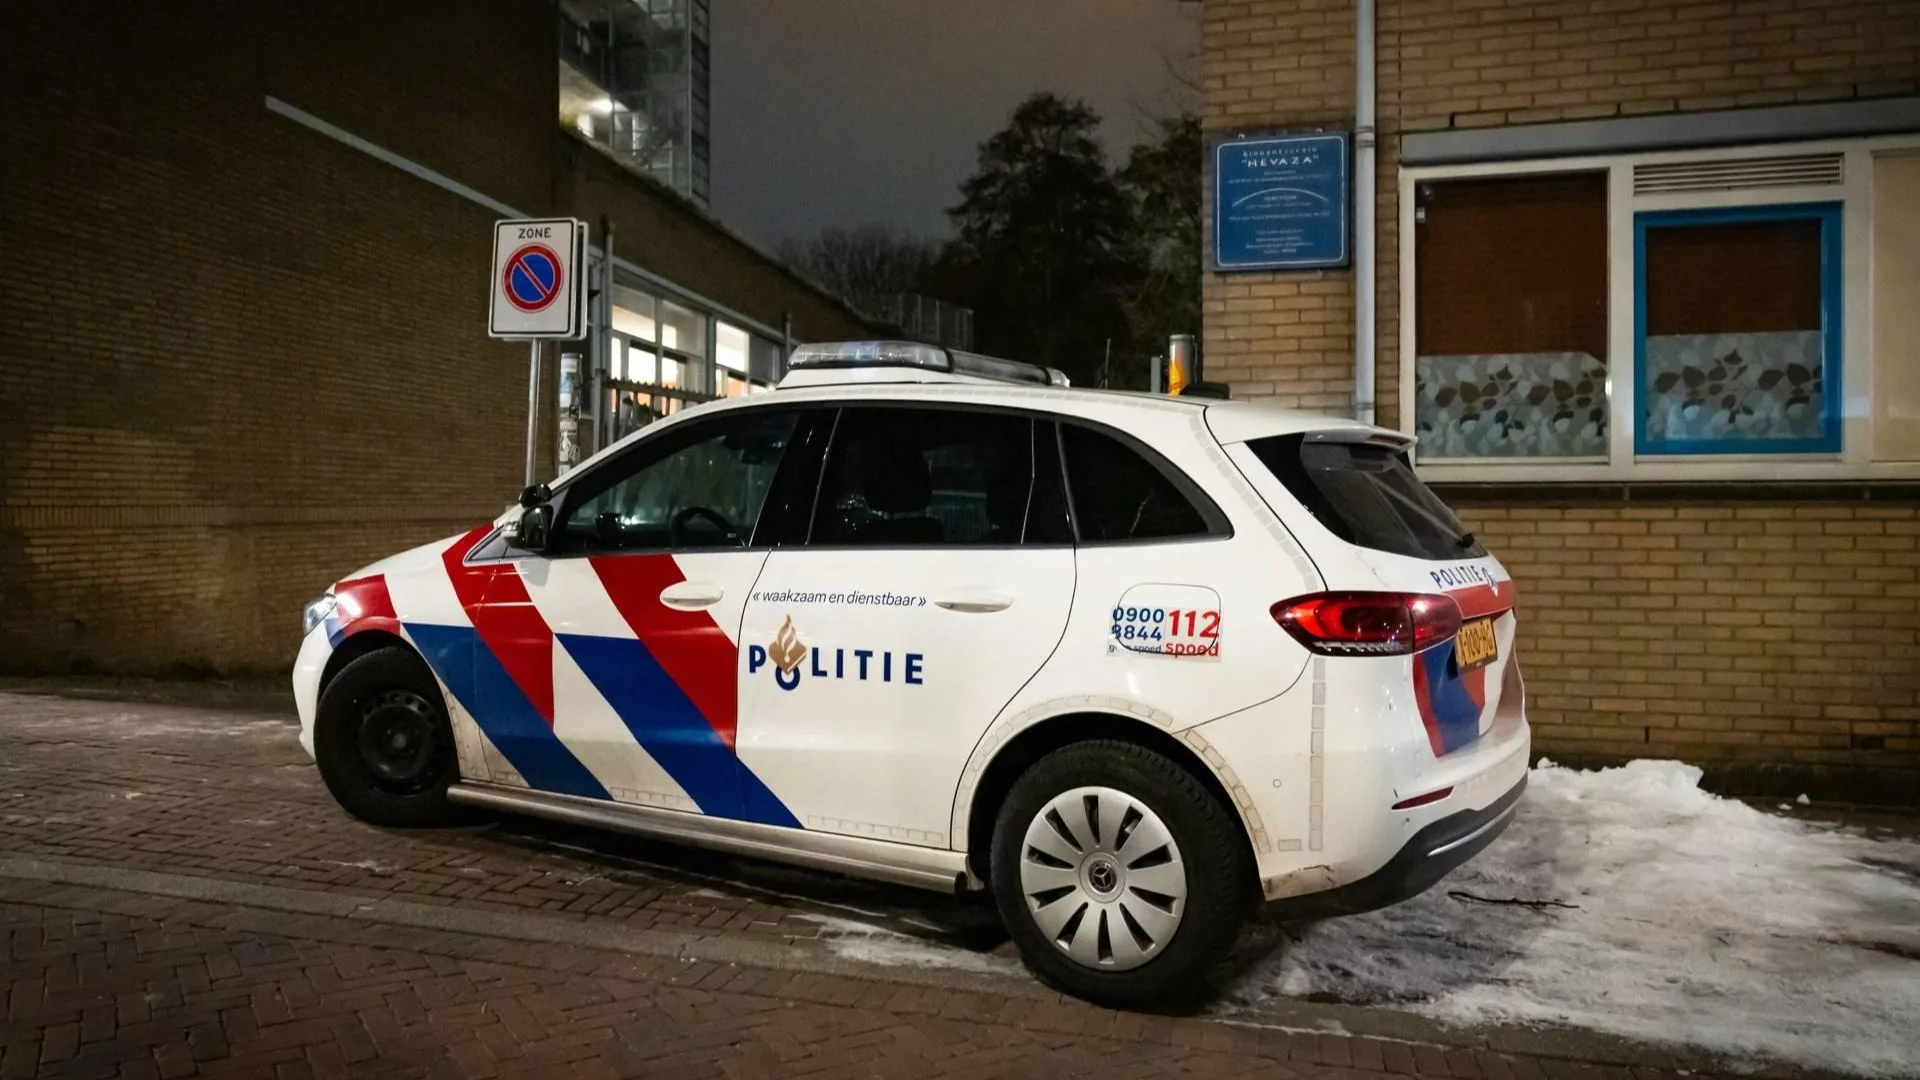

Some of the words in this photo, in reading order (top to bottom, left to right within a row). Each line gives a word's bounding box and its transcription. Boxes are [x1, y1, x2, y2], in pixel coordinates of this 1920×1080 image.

[518, 227, 552, 239] ZONE
[1430, 565, 1483, 589] POLITIE
[830, 591, 845, 604] en
[1112, 606, 1165, 623] 0900
[1168, 609, 1221, 638] 112
[1111, 624, 1163, 641] 8844
[1165, 642, 1219, 658] spoed
[749, 644, 924, 691] POLITIE
